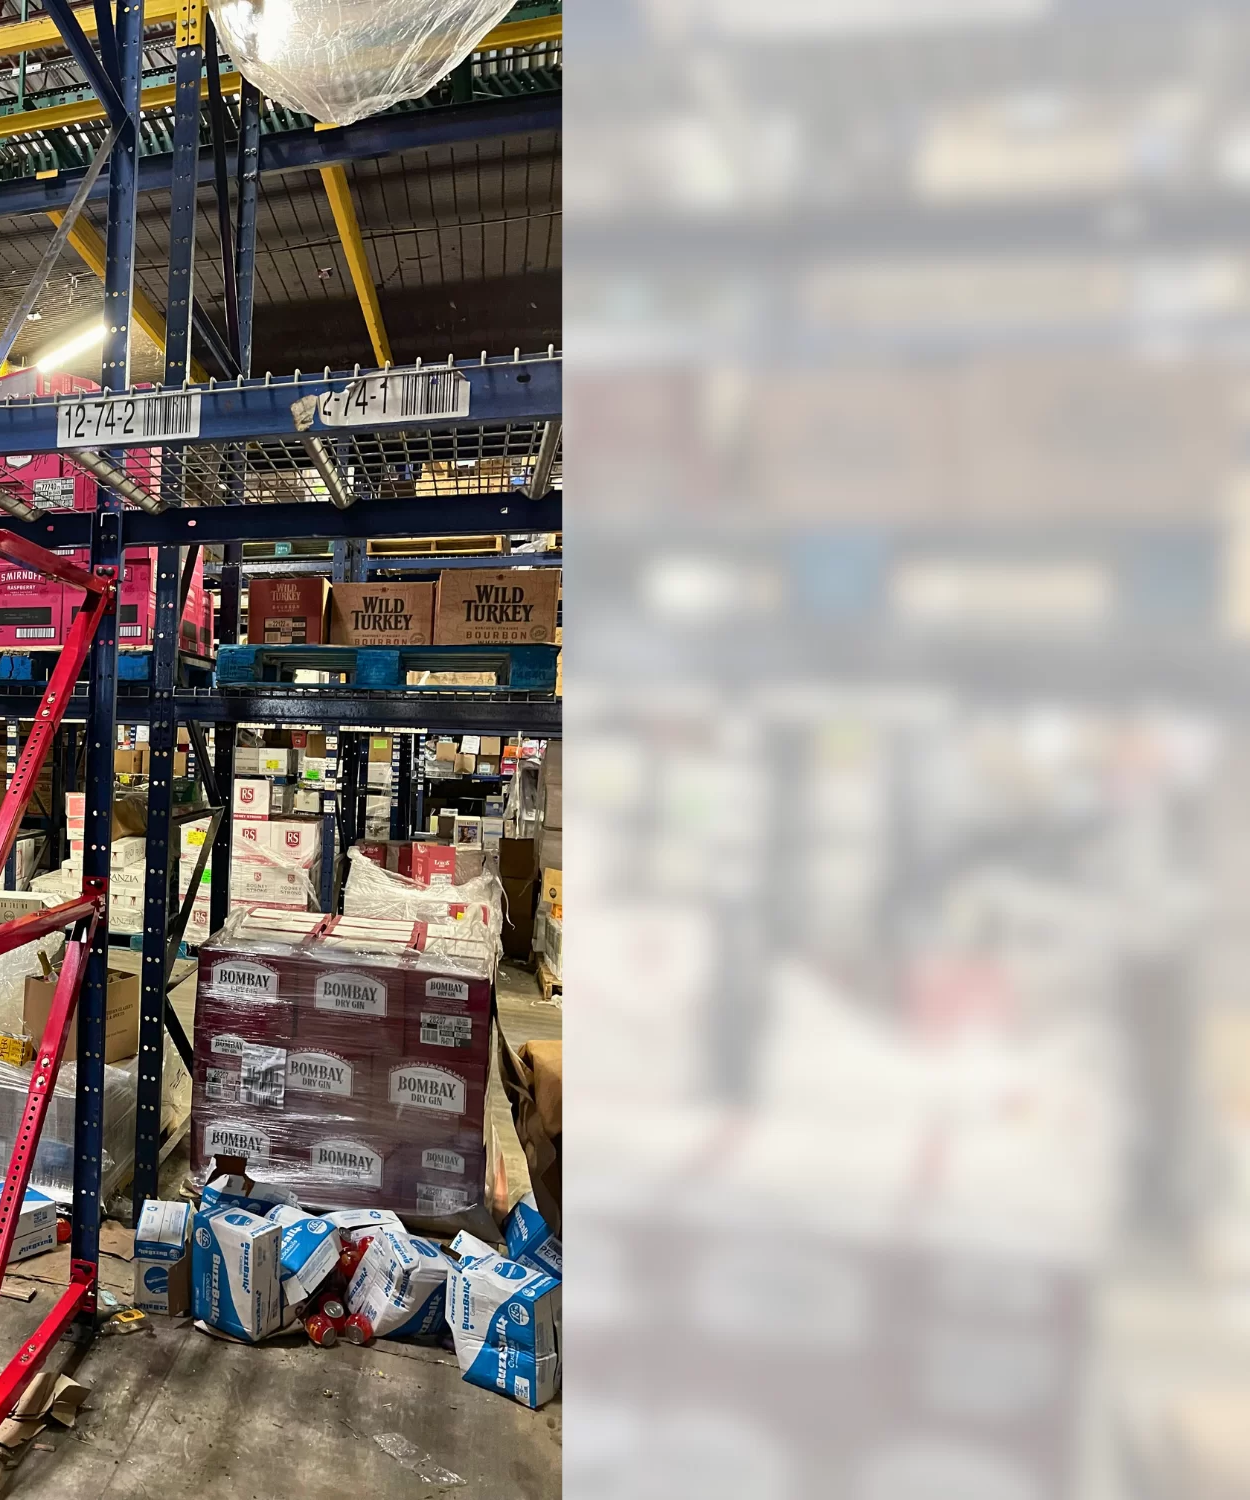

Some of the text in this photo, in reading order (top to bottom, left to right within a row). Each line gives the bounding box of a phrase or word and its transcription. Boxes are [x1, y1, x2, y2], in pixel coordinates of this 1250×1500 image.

[322, 378, 388, 416] 2-74-1
[65, 401, 135, 438] 12-74-2
[0, 570, 43, 582] SMIRNOFF
[271, 591, 301, 601] TURKEY
[276, 583, 297, 593] WILD
[475, 585, 525, 604] WILD
[361, 596, 405, 614] WILD
[462, 600, 535, 624] TURKEY
[351, 610, 414, 632] TURKEY
[354, 638, 408, 646] BOURBON
[466, 631, 528, 640] BOURBON
[242, 788, 253, 800] RS
[287, 832, 299, 844] RS
[110, 874, 139, 884] ANZIA
[110, 917, 135, 925] ANZIA
[219, 969, 271, 991] BOMBAY
[430, 981, 464, 994] BOMBAY
[322, 981, 378, 1004] BOMBAY
[335, 999, 365, 1010] DRY GIN
[290, 1060, 344, 1084] BOMBAY
[302, 1077, 332, 1090] DRY GIN
[397, 1075, 456, 1101] BOMBAY
[411, 1093, 443, 1107] DRY GIN
[211, 1129, 263, 1153] BOMBAY
[318, 1148, 374, 1172] BOMBAY
[426, 1152, 460, 1168] BOMBAY
[540, 1244, 562, 1266] PEAC
